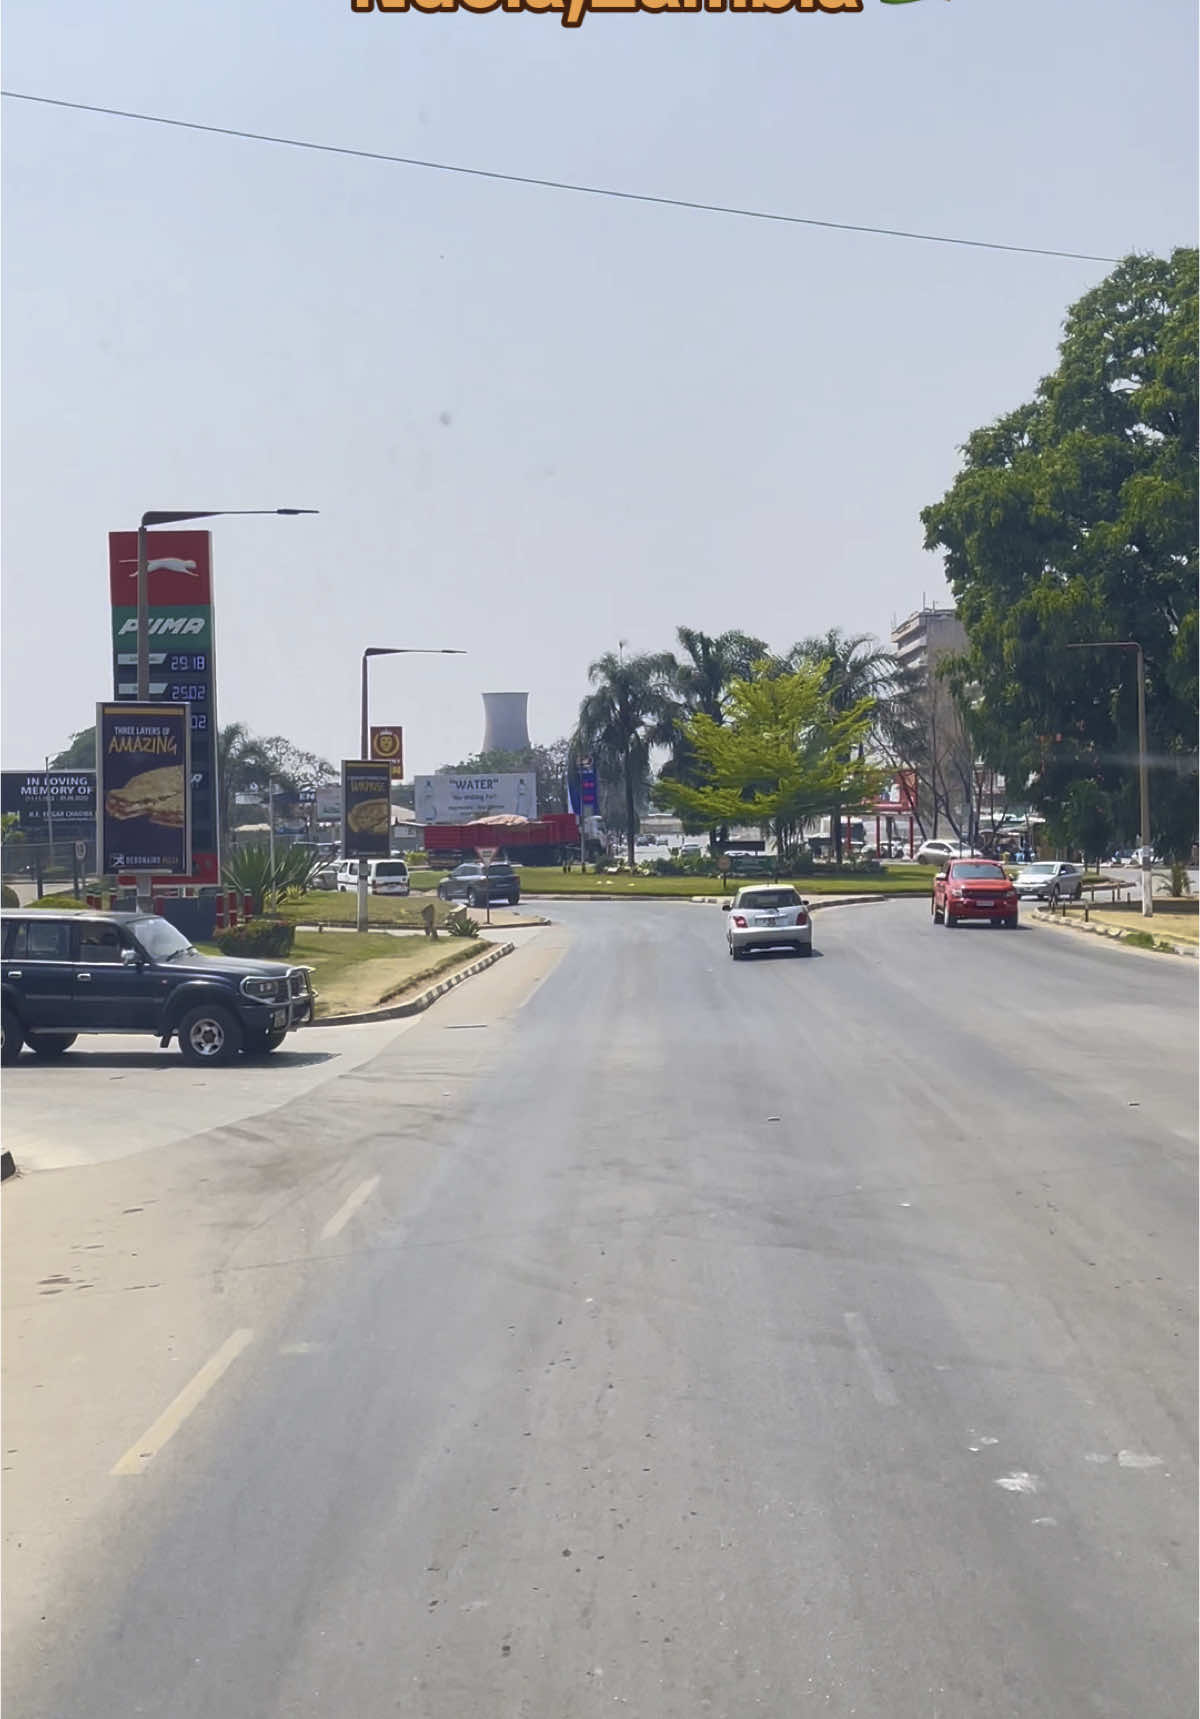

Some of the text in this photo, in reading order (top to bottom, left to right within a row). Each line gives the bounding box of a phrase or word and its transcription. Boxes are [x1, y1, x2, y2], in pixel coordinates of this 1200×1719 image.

[117, 617, 206, 636] PUMA
[108, 734, 178, 756] AMAZING
[26, 776, 40, 786] IN
